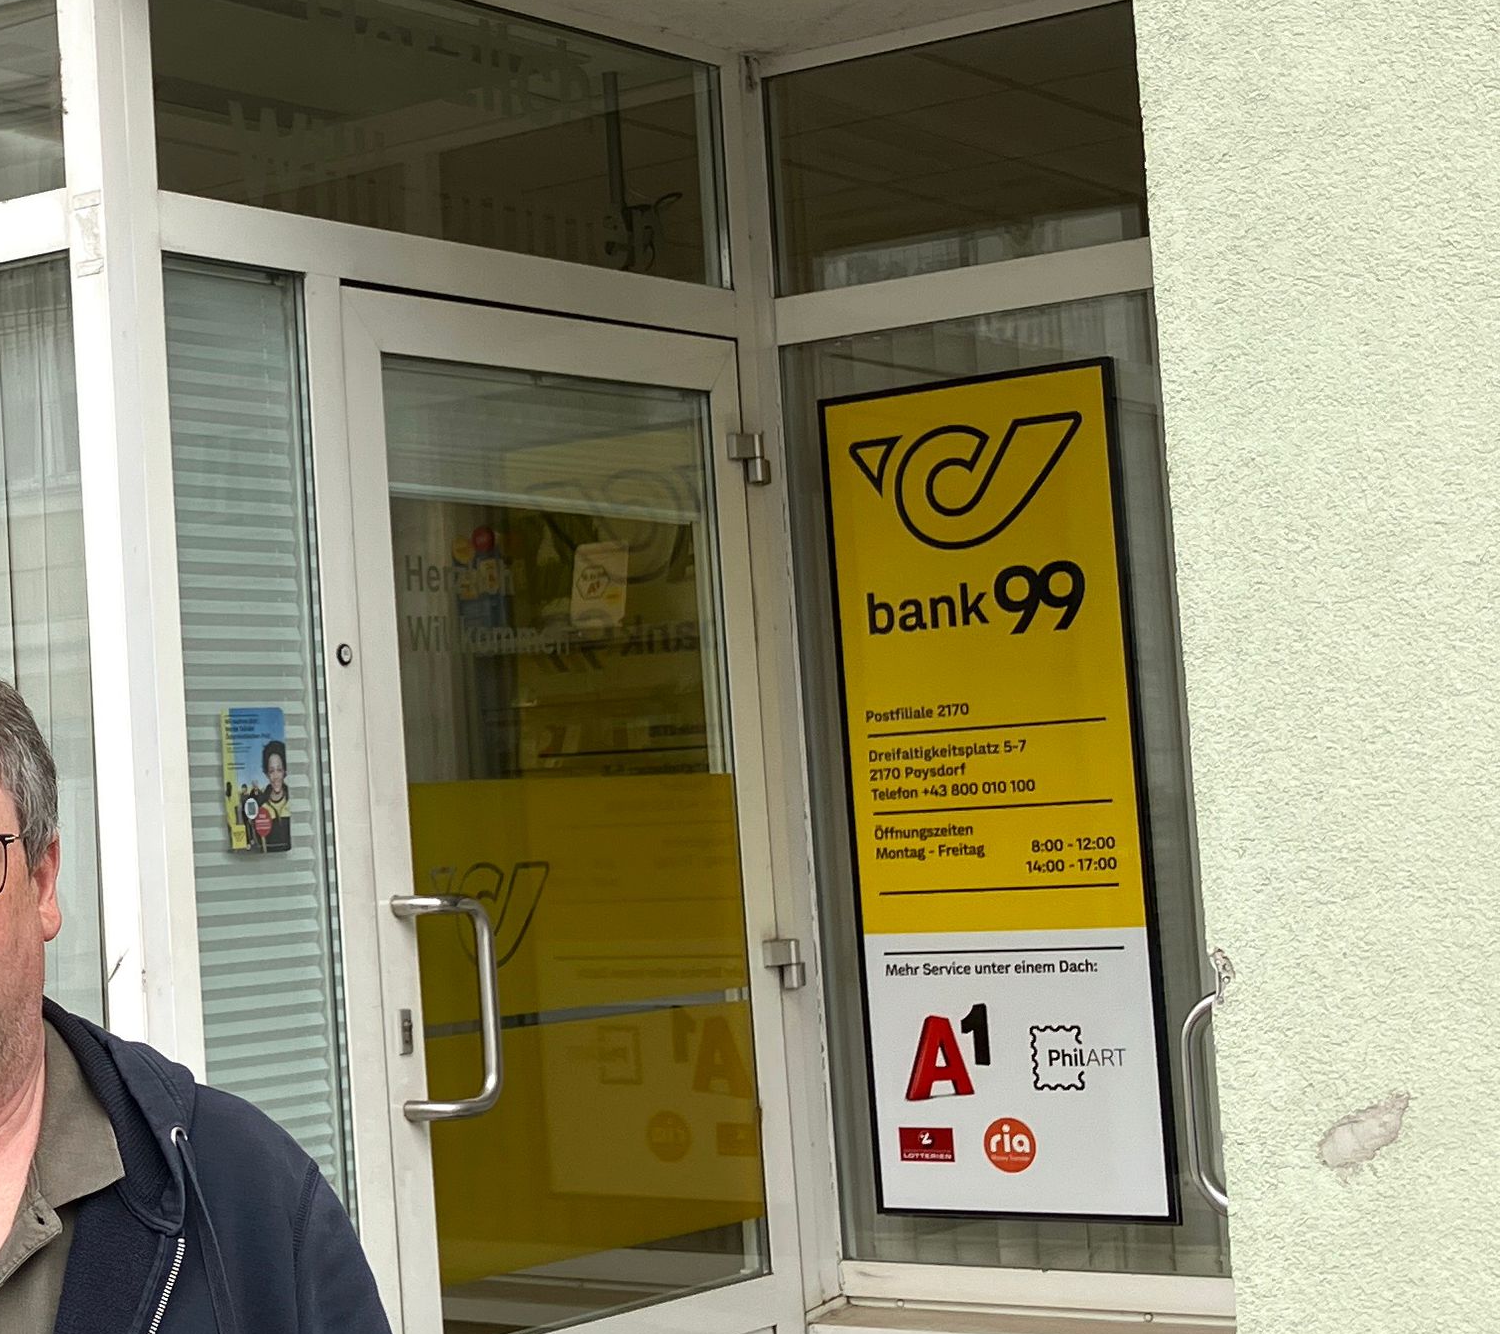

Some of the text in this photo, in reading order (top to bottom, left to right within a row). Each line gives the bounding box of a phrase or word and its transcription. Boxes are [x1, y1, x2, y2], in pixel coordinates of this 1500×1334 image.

[866, 703, 969, 723] Postfiliale 2170
[869, 739, 1027, 762] Dreifaltigkeitsplatz 5-7
[870, 762, 966, 781] 2170 Poysdorf
[872, 779, 1036, 801] Telefon +43 800 010 100
[874, 823, 974, 841] Öffnungszeiten
[876, 846, 925, 861] Montag
[938, 843, 985, 859] Freitag
[1031, 839, 1063, 853] 8:00
[1077, 836, 1116, 851] 12:00
[1026, 859, 1065, 874] 14:00
[1078, 857, 1118, 871] 17:00
[885, 959, 1098, 977] Mehr Service unter einem Dach:
[905, 1003, 991, 1101] A1
[1048, 1047, 1126, 1067] PhilART
[990, 1124, 1031, 1153] ria
